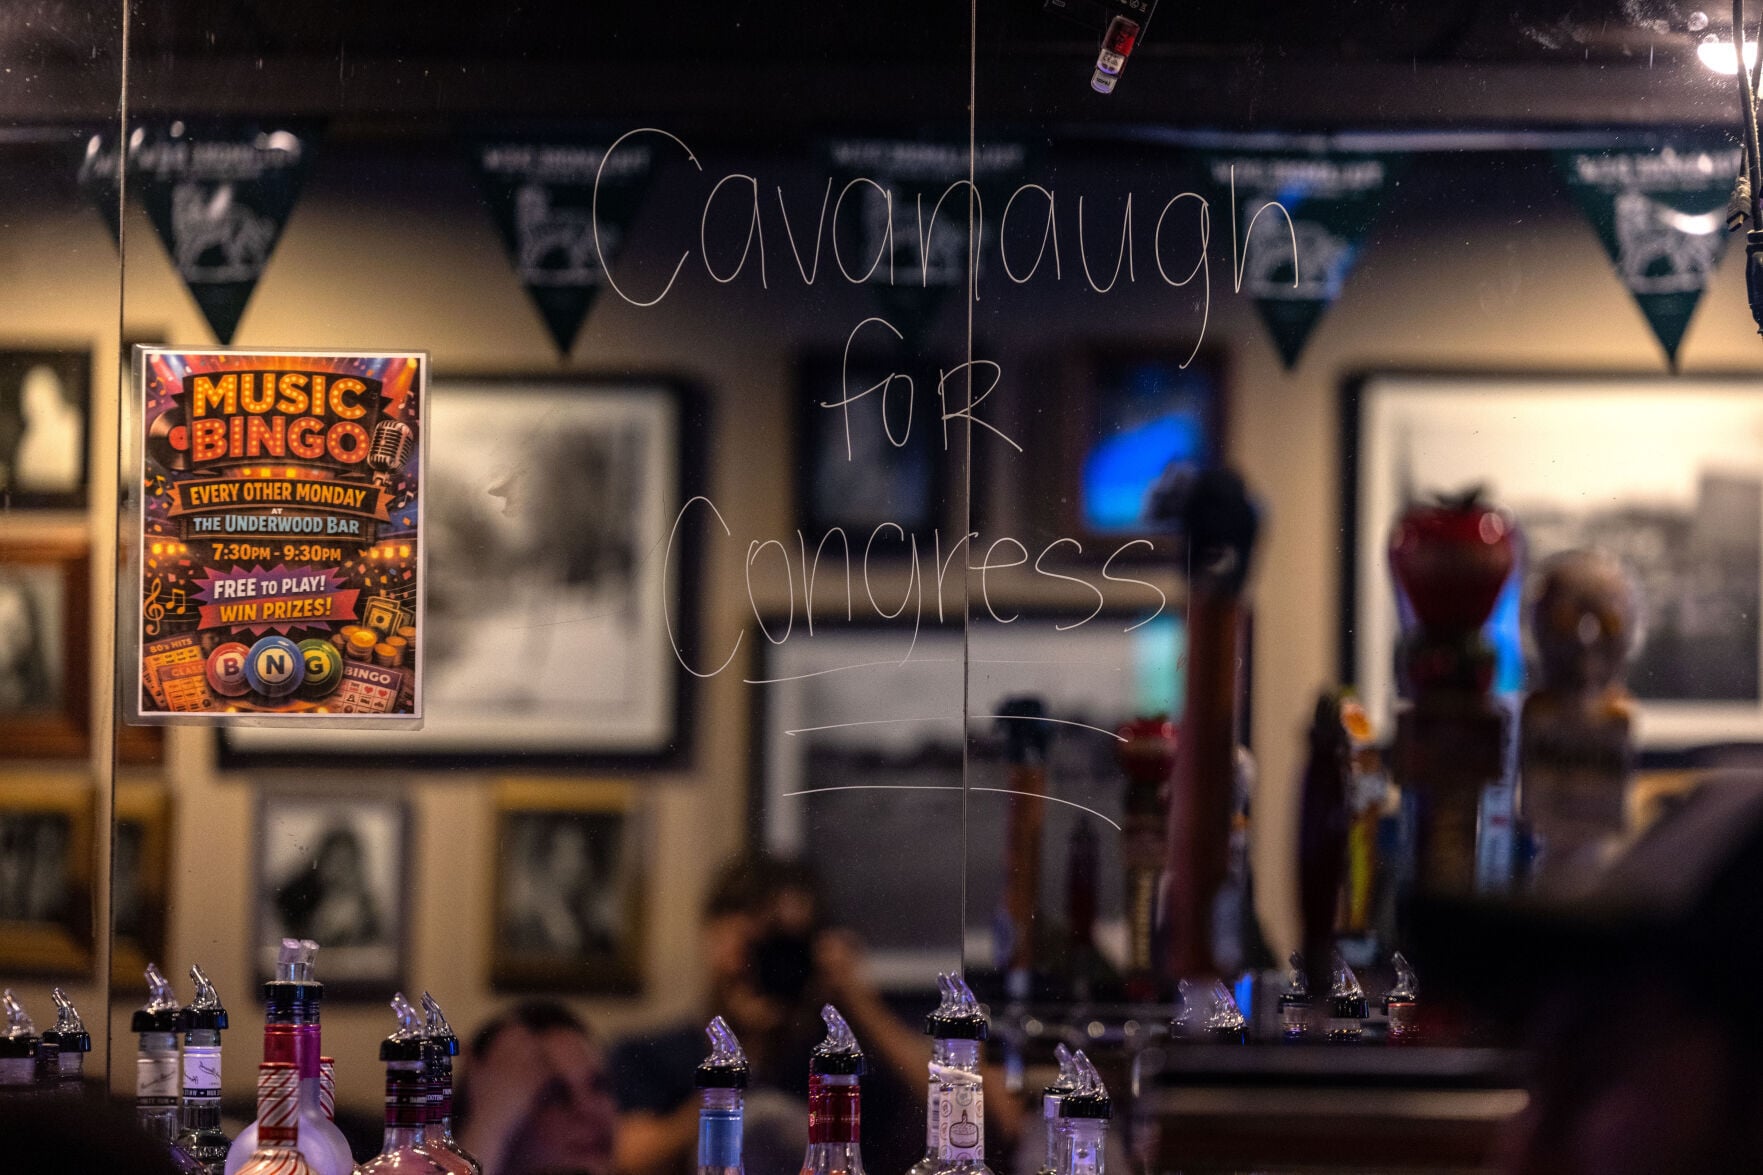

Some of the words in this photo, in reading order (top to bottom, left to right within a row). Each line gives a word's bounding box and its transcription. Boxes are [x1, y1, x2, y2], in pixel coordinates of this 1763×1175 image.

[592, 127, 1300, 370] Cavanaugh
[193, 373, 367, 419] MUSIC
[192, 416, 370, 463] BINGO
[189, 483, 240, 505] EVERY
[243, 482, 292, 501] OTHER
[296, 483, 366, 508] MONDAY
[193, 517, 221, 531] THE
[225, 514, 323, 533] UNDERWOOD
[326, 516, 360, 534] BAR
[212, 543, 271, 561] 7:30PM
[283, 545, 342, 561] 9:30PM
[213, 578, 257, 599] FREE
[260, 580, 278, 595] TO
[281, 575, 326, 594] PLAY!
[662, 495, 1167, 678] Congress
[219, 603, 257, 623] WIN
[262, 597, 332, 620] PRIZES!
[170, 637, 193, 649] HITS
[223, 657, 241, 677] B
[265, 648, 285, 675] N
[305, 656, 323, 675] G
[344, 666, 391, 685] BINGO
